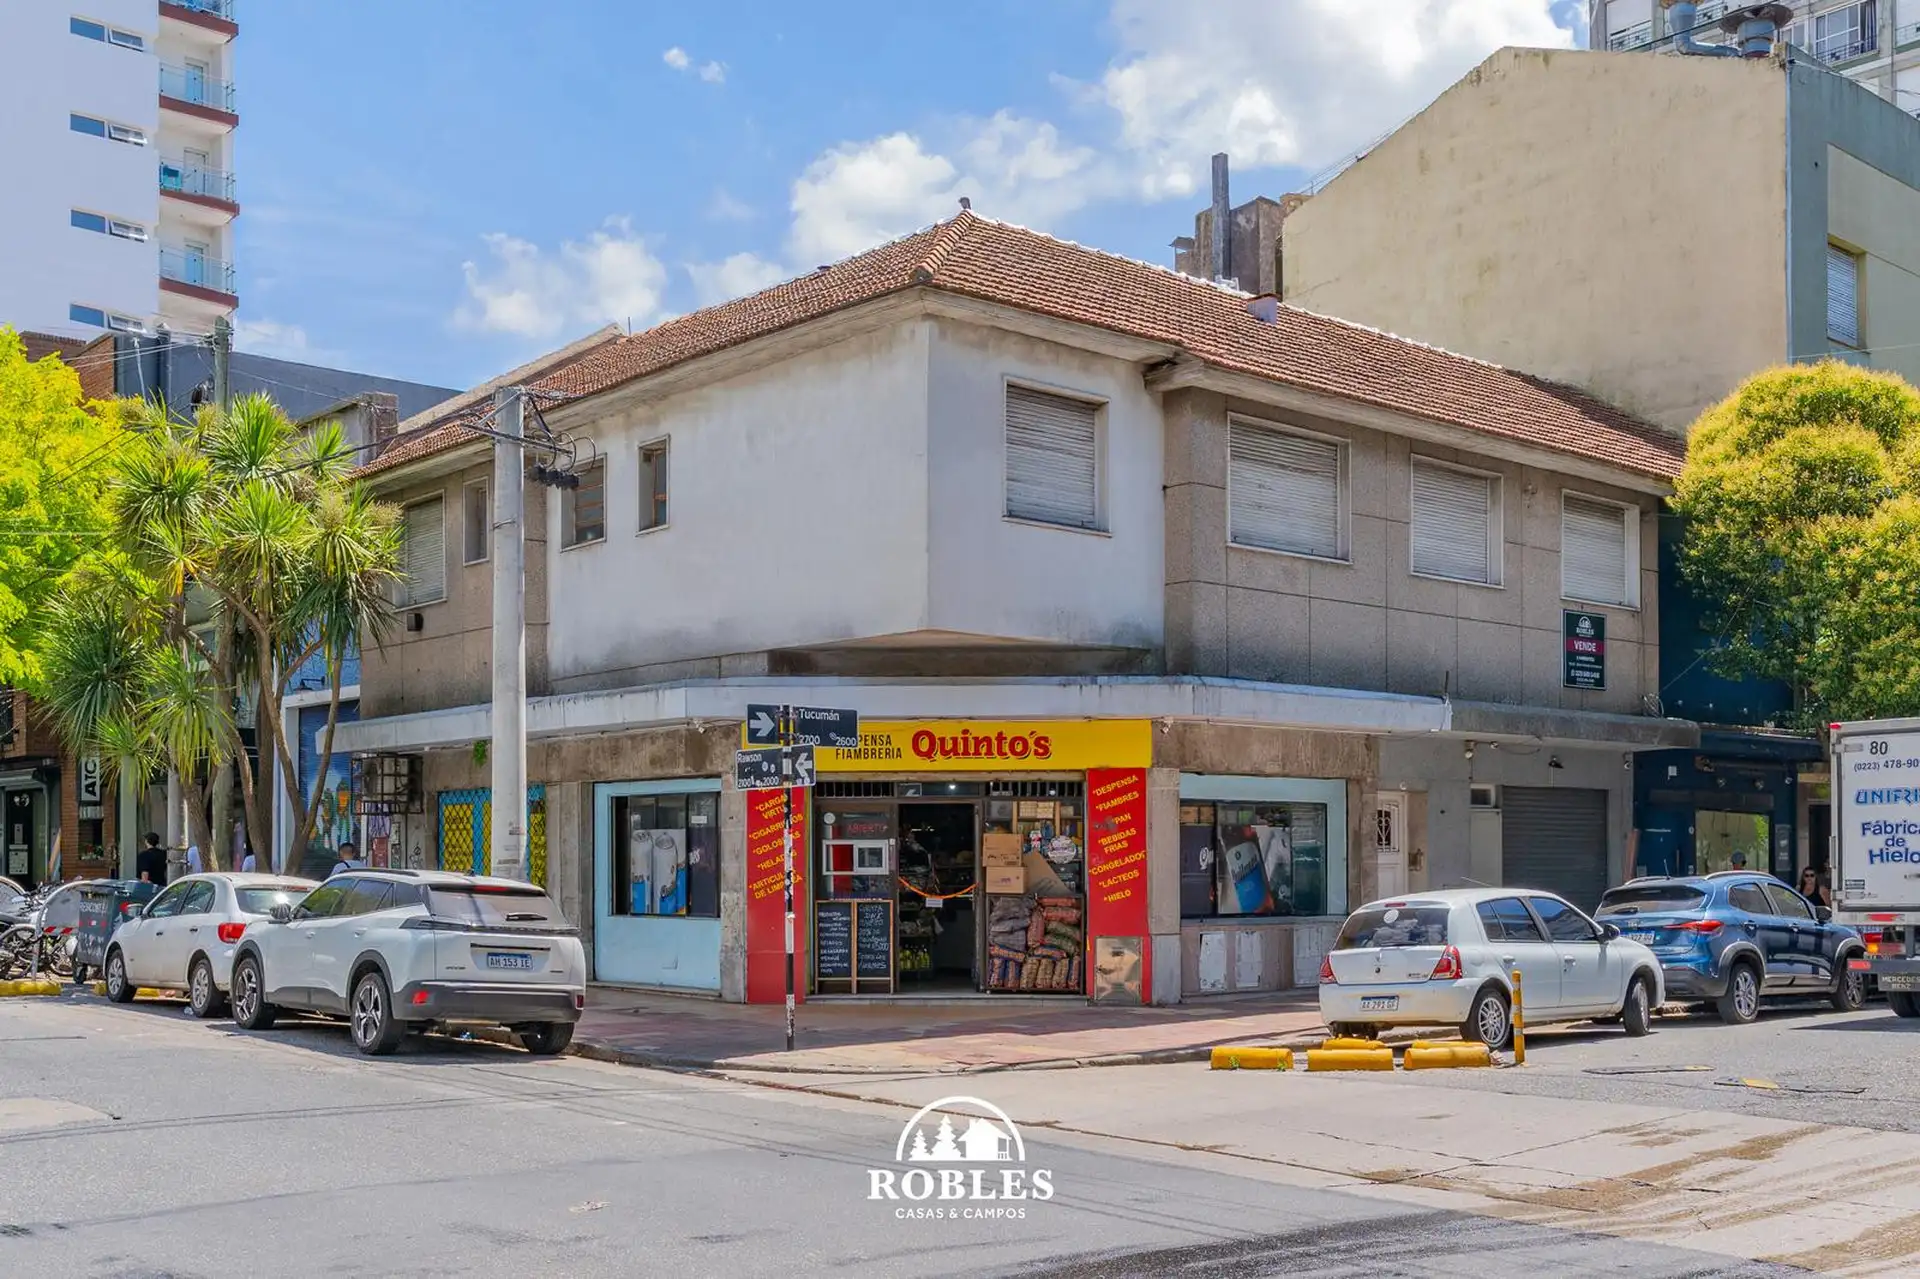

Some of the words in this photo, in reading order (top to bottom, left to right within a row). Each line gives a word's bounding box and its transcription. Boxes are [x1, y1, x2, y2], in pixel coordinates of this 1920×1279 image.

[1573, 640, 1597, 652] VENDE
[799, 708, 840, 721] Tucumán
[800, 735, 820, 745] 2700
[836, 737, 857, 747] 2600
[858, 734, 892, 747] PENSA
[1870, 740, 1889, 755] 80
[835, 747, 903, 760] FIAMBRERIA
[1854, 761, 1880, 773] (0223)
[1095, 774, 1139, 797] DESPENSA
[1099, 790, 1140, 812] FIAMBRES
[1856, 788, 1920, 805] UNIFRI
[762, 803, 796, 820] VIRTU
[1114, 812, 1132, 825] PAN
[751, 812, 804, 841] CIGARRIOS
[1861, 819, 1920, 836] Fábric
[1100, 827, 1137, 846] BEBIDAS
[1884, 835, 1906, 848] de
[1103, 840, 1129, 855] FRIAS
[759, 848, 798, 871] HELADS
[1868, 847, 1920, 865] Hielo
[1101, 868, 1140, 889] LACTEOS
[1107, 888, 1132, 903] HIELO
